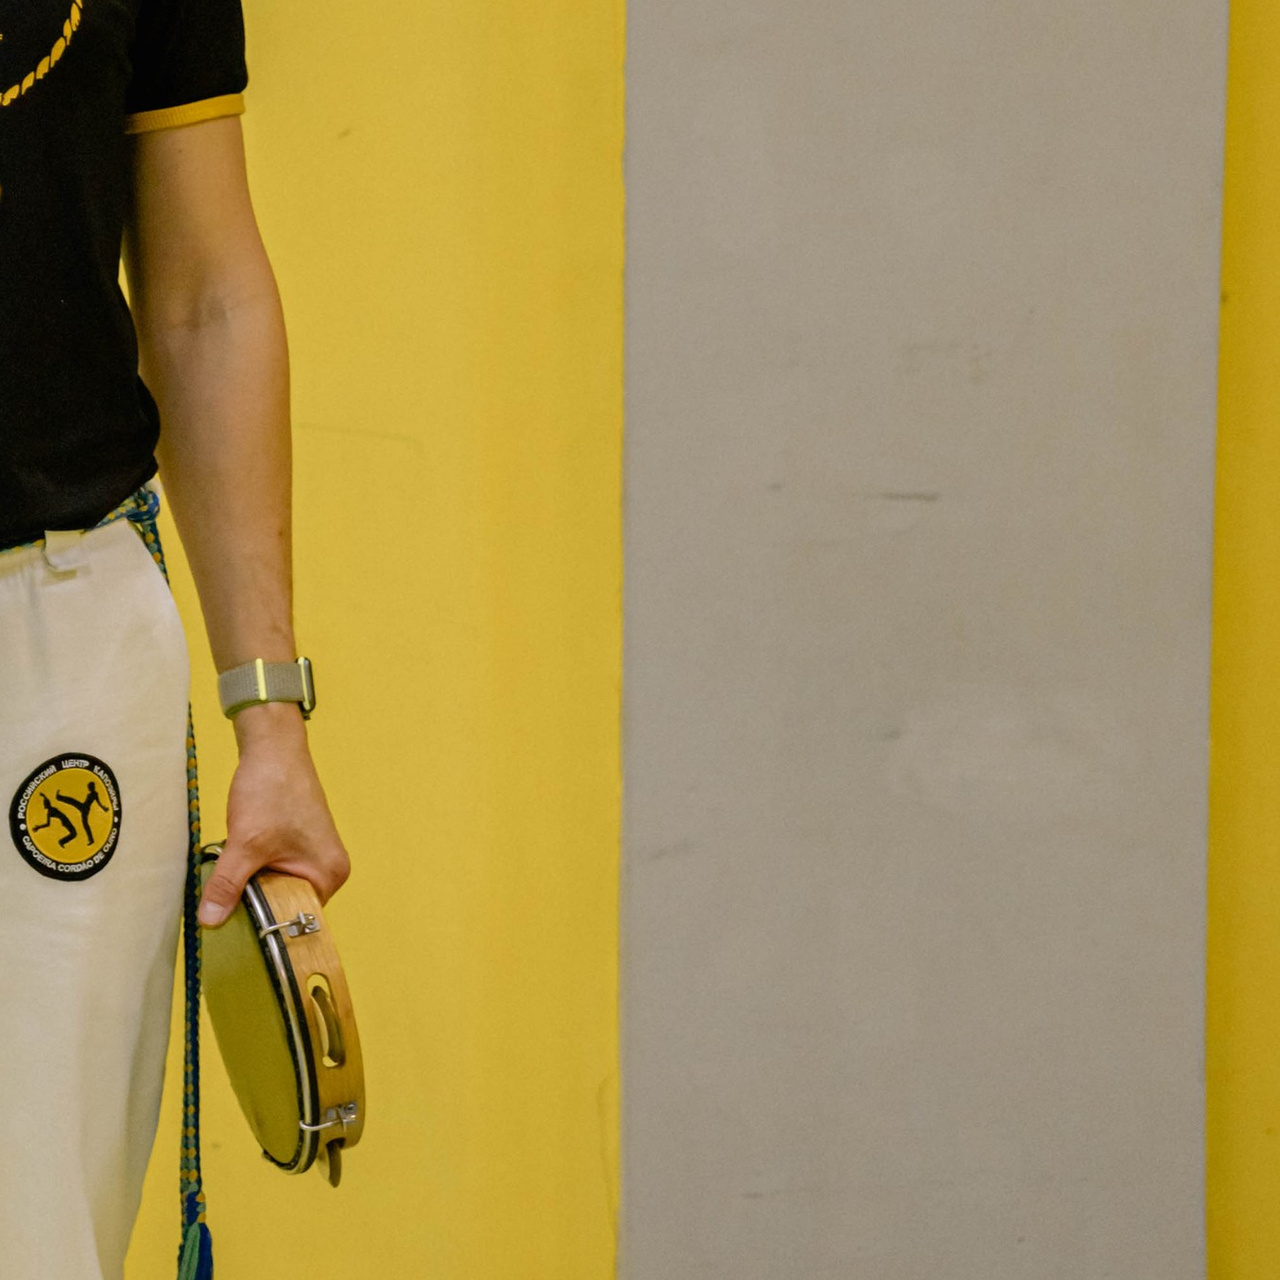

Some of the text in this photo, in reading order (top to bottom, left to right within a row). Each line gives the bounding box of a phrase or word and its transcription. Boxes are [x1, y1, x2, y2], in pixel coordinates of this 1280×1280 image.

[22, 835, 57, 870] CAPOEIRA
[93, 851, 105, 864] DE
[103, 828, 117, 852] OURO
